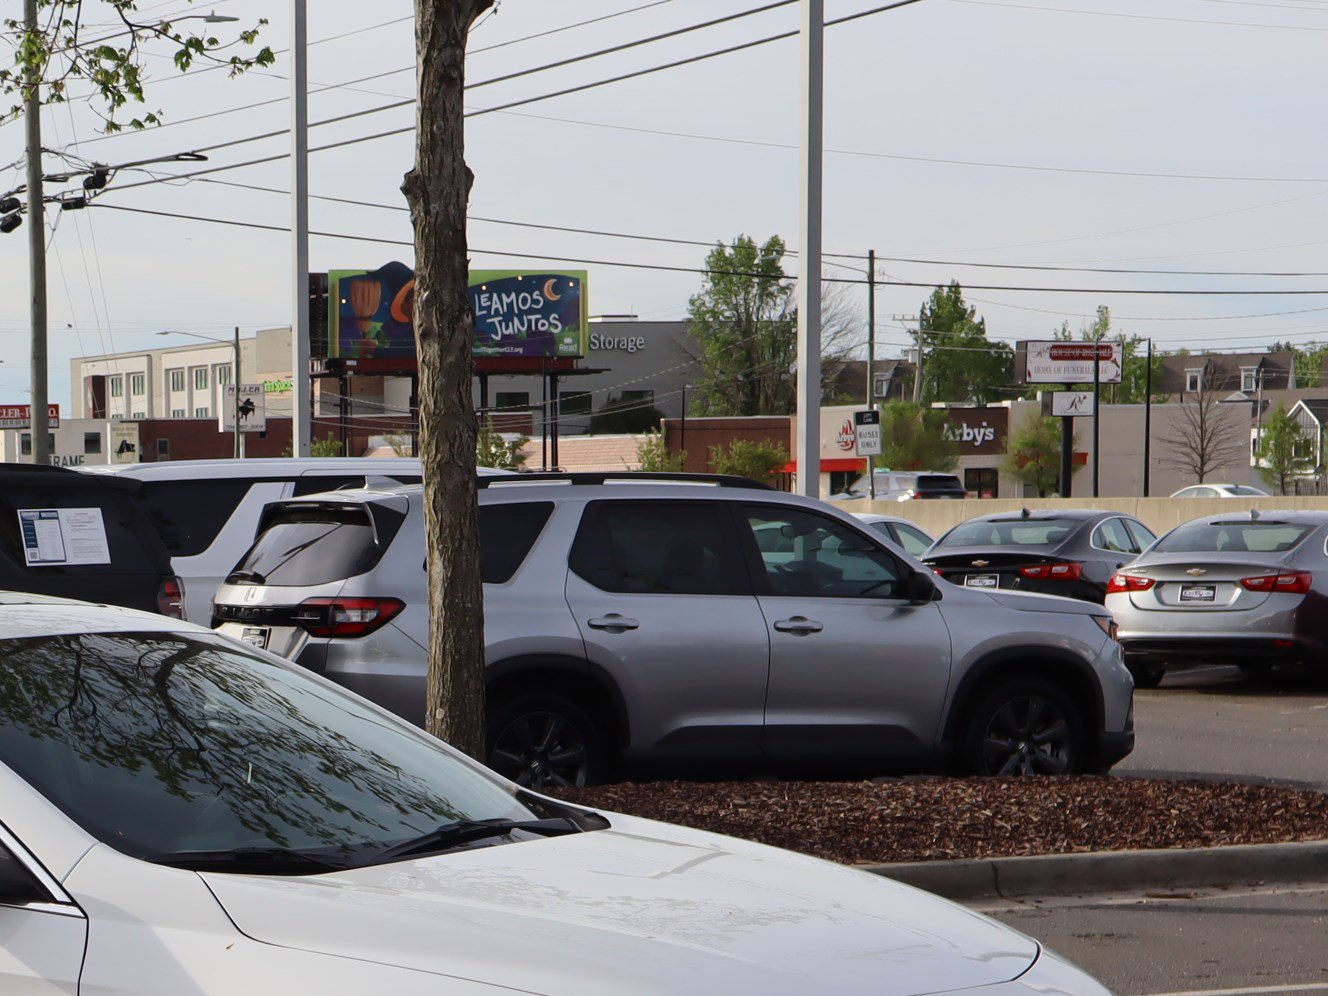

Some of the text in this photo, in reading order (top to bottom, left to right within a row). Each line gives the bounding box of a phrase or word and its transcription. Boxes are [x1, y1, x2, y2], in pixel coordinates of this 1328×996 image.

[475, 289, 545, 317] LEAMOS
[558, 342, 579, 353] Read
[590, 332, 645, 354] Storage
[227, 386, 261, 394] MLLER
[858, 431, 879, 439] BUSES
[942, 421, 995, 446] Arby's
[861, 441, 877, 449] ONLY
